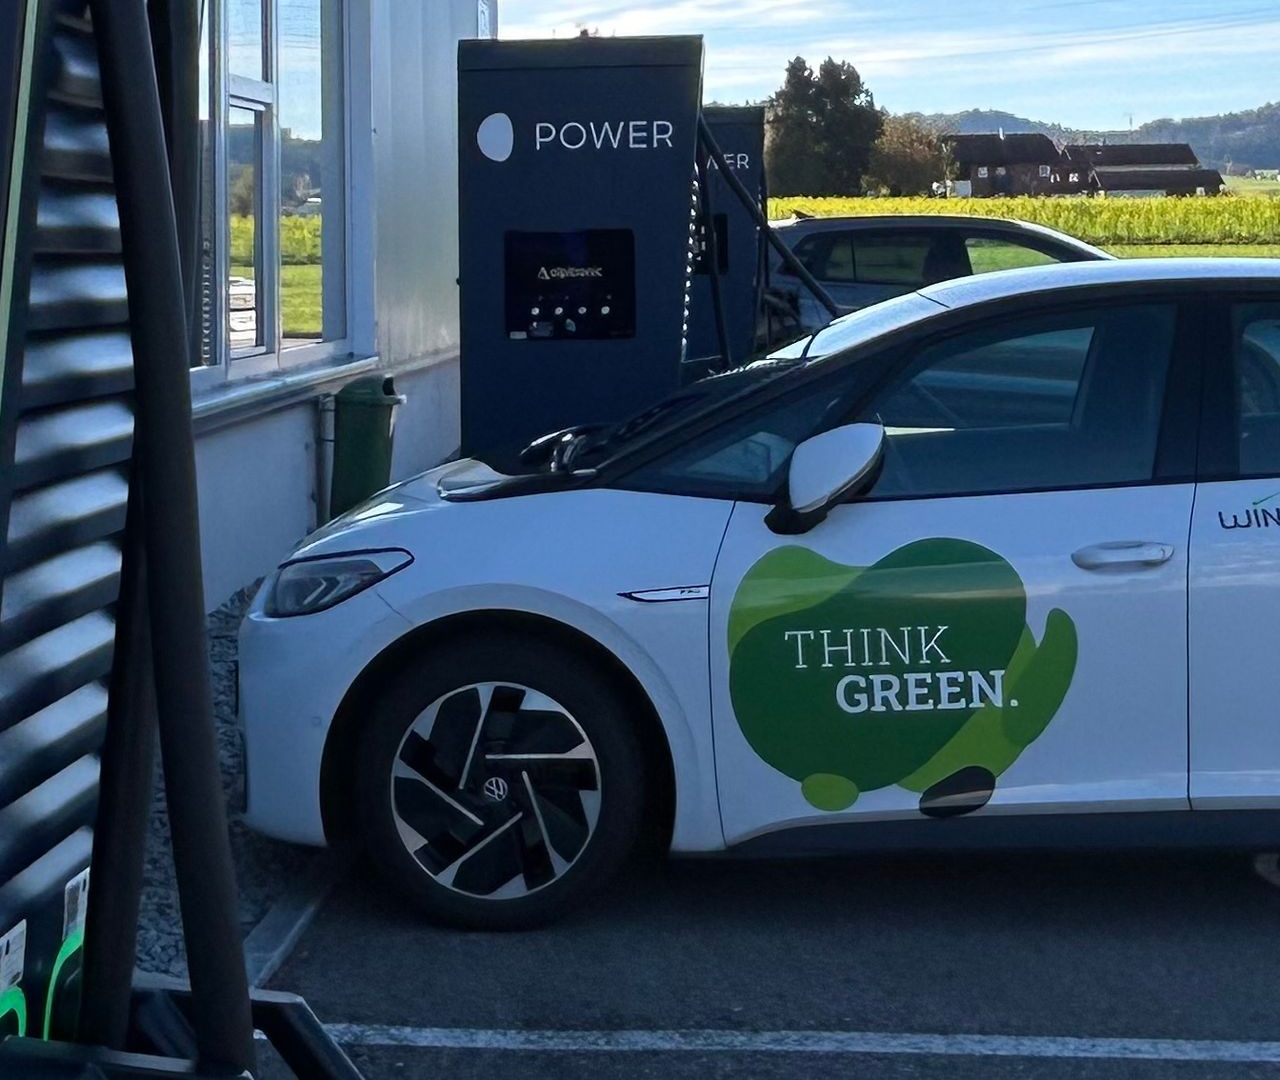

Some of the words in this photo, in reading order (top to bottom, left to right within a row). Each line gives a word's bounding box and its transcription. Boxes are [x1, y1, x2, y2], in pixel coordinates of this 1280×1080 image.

[535, 120, 673, 150] POWER
[785, 626, 951, 669] THINK
[836, 670, 1019, 713] GREEN.
